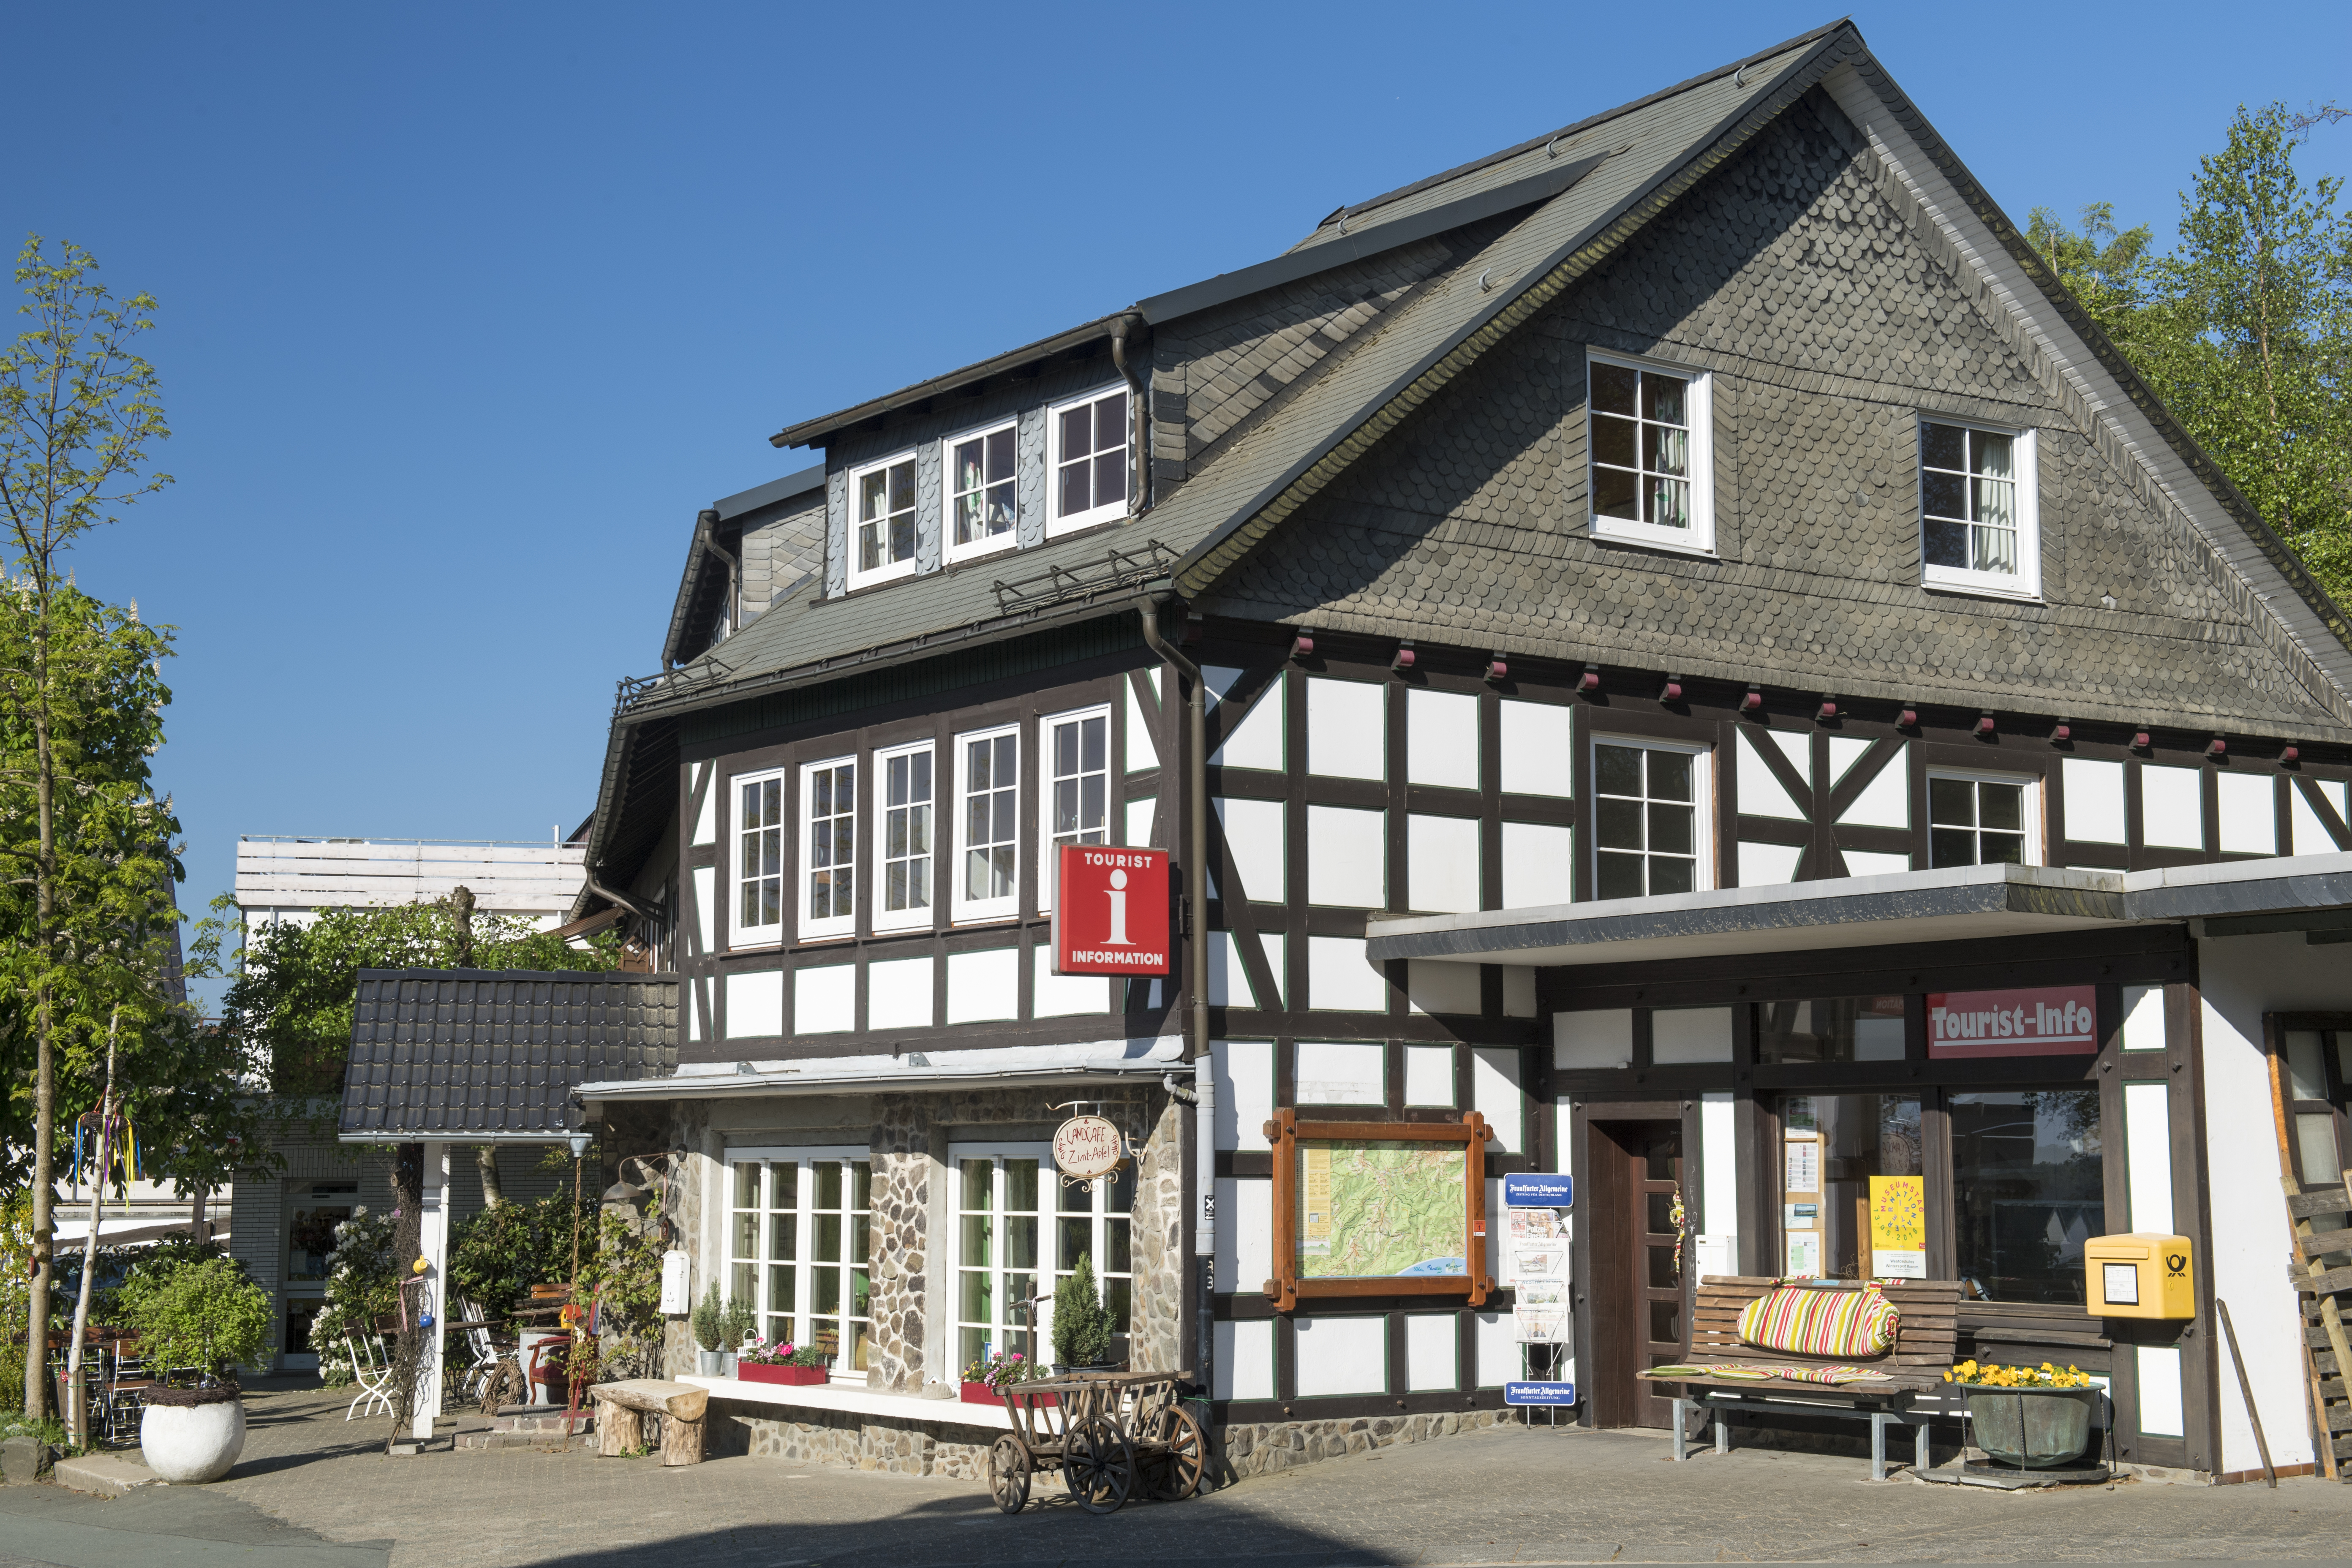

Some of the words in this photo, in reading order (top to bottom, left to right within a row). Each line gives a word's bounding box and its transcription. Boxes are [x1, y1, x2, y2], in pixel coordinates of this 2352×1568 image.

[1084, 853, 1152, 868] TOURIST
[1073, 950, 1163, 965] INFORMATION
[1932, 1000, 2092, 1039] Tourist-Info
[1067, 1126, 1106, 1145] LANDCAFÉ
[1509, 1184, 1539, 1193] Frankfurter
[1538, 1184, 1568, 1193] Allgemeine
[1881, 1181, 1924, 1212] MUSEUMSTAG
[1527, 1225, 1547, 1233] Polizei-
[1511, 1386, 1540, 1395] Frankfurter
[1540, 1387, 1570, 1396] Allgemeine
